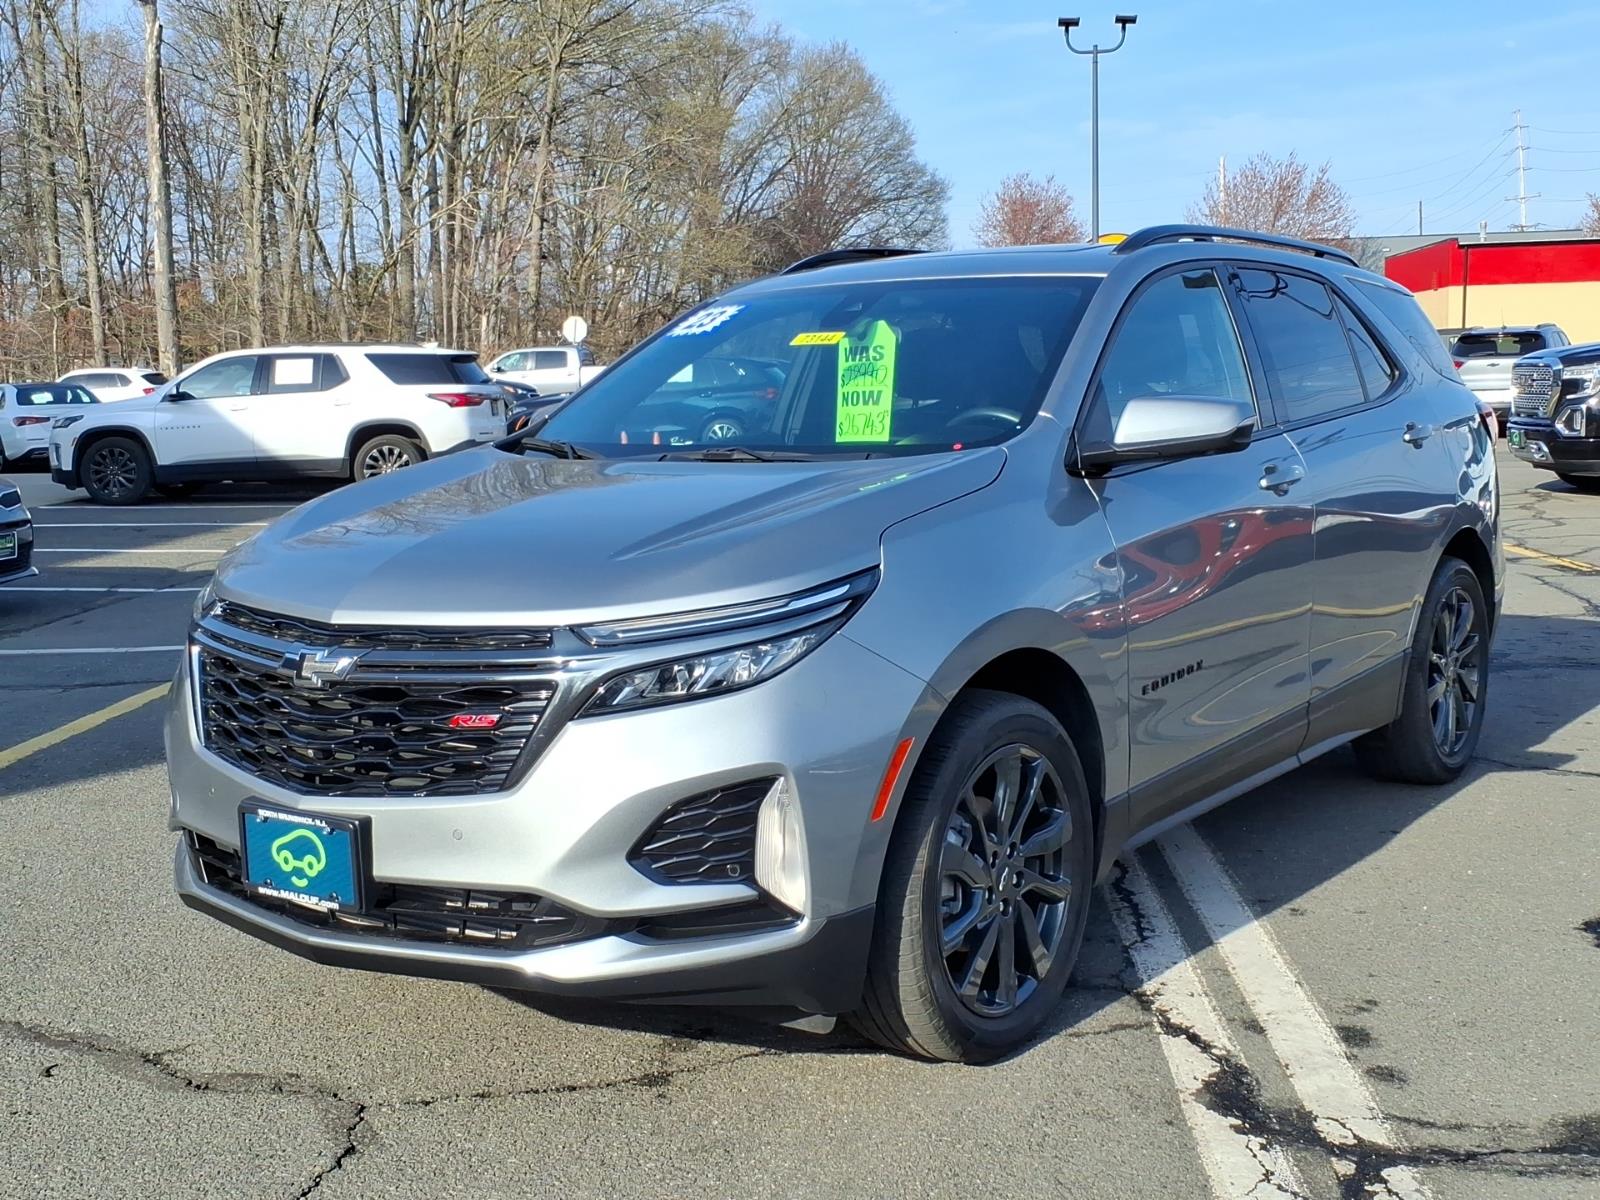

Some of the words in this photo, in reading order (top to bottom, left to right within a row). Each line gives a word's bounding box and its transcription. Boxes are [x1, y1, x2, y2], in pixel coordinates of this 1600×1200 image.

[844, 344, 885, 363] WAS
[842, 390, 883, 407] NOW
[1141, 659, 1204, 696] EQUINOX
[449, 714, 501, 727] RS
